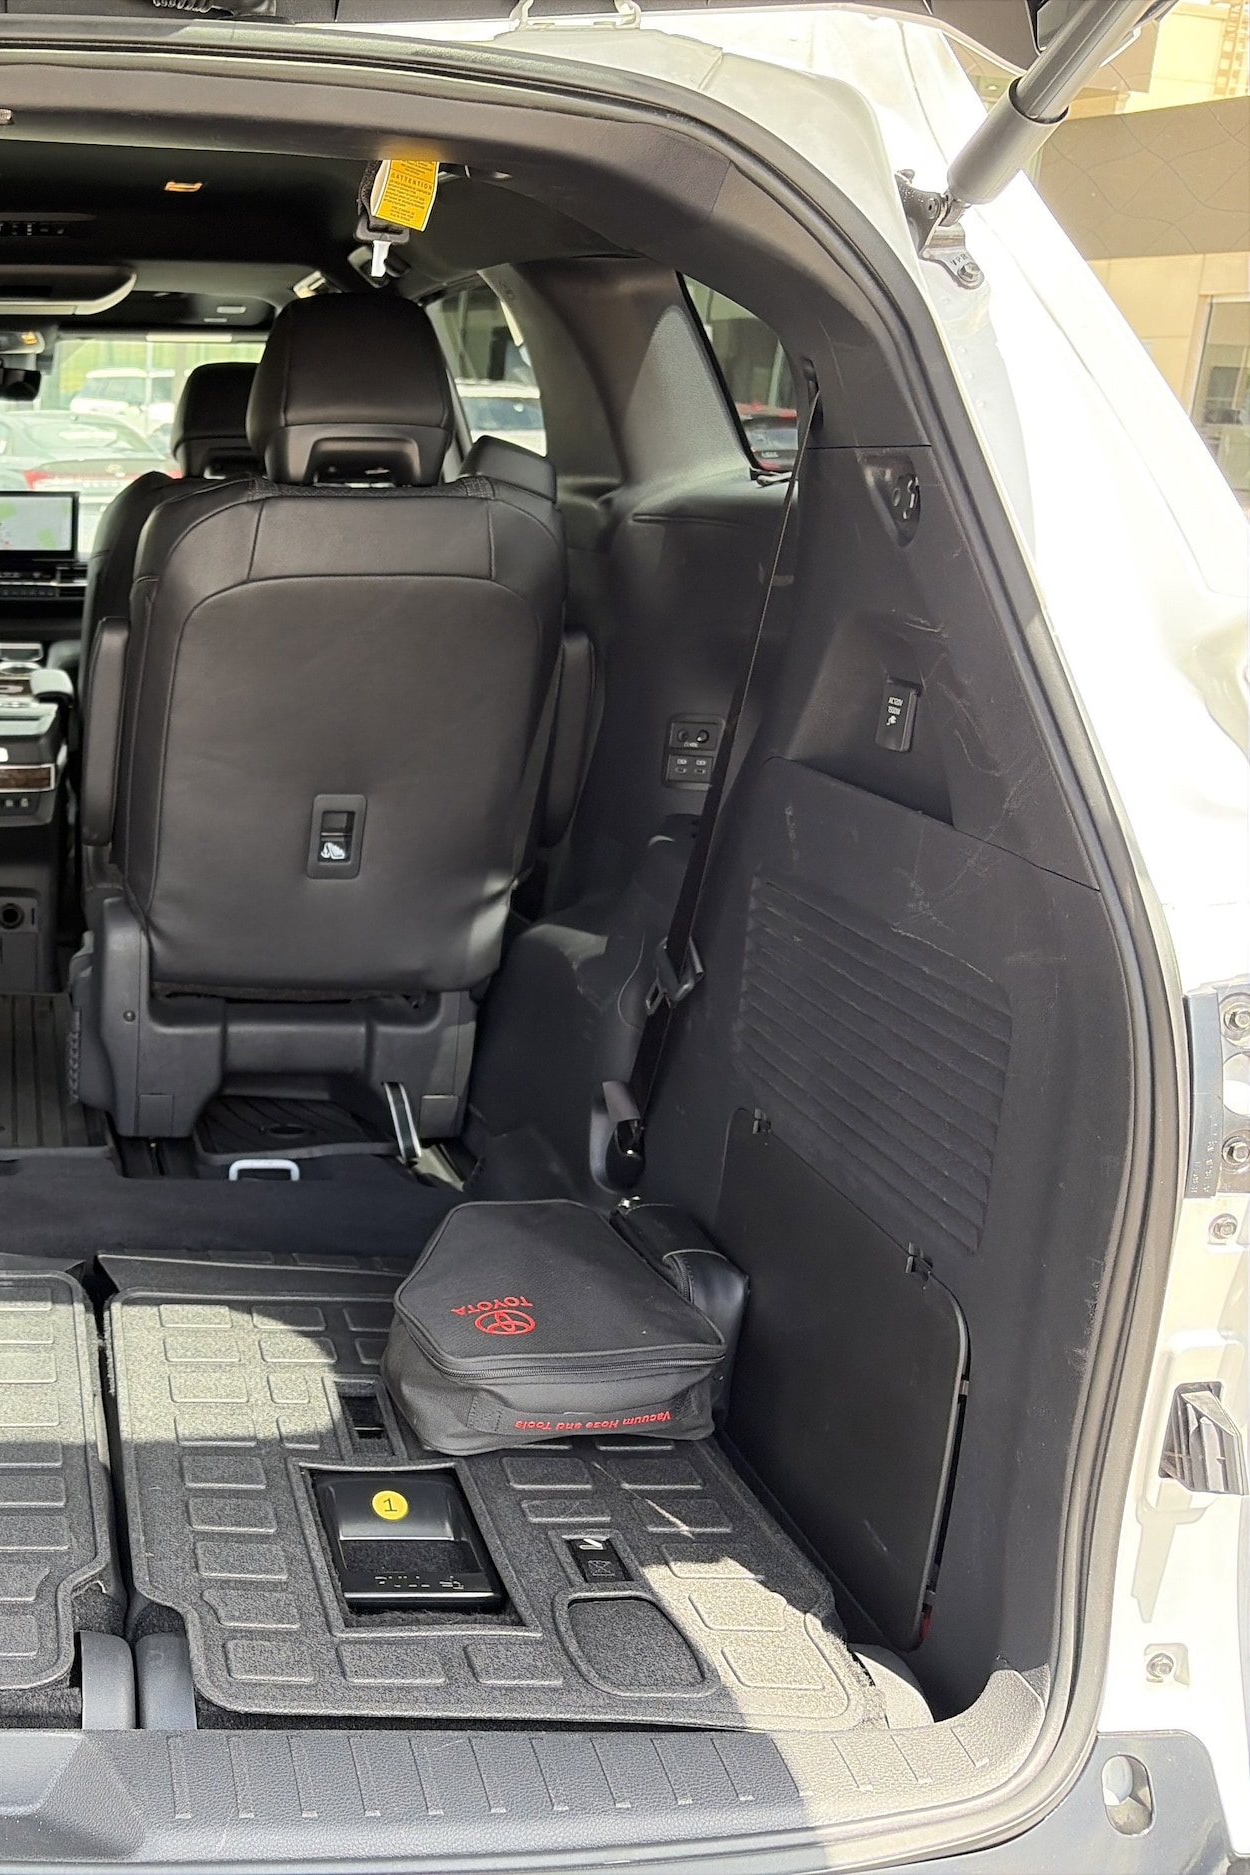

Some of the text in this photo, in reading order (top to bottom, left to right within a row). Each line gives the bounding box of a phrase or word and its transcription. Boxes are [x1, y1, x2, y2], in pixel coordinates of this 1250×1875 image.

[396, 174, 432, 190] ATTENTION
[450, 1295, 533, 1316] TOYOTA
[515, 1411, 671, 1431] Vacuum Hose and Tools
[383, 1497, 398, 1512] 1
